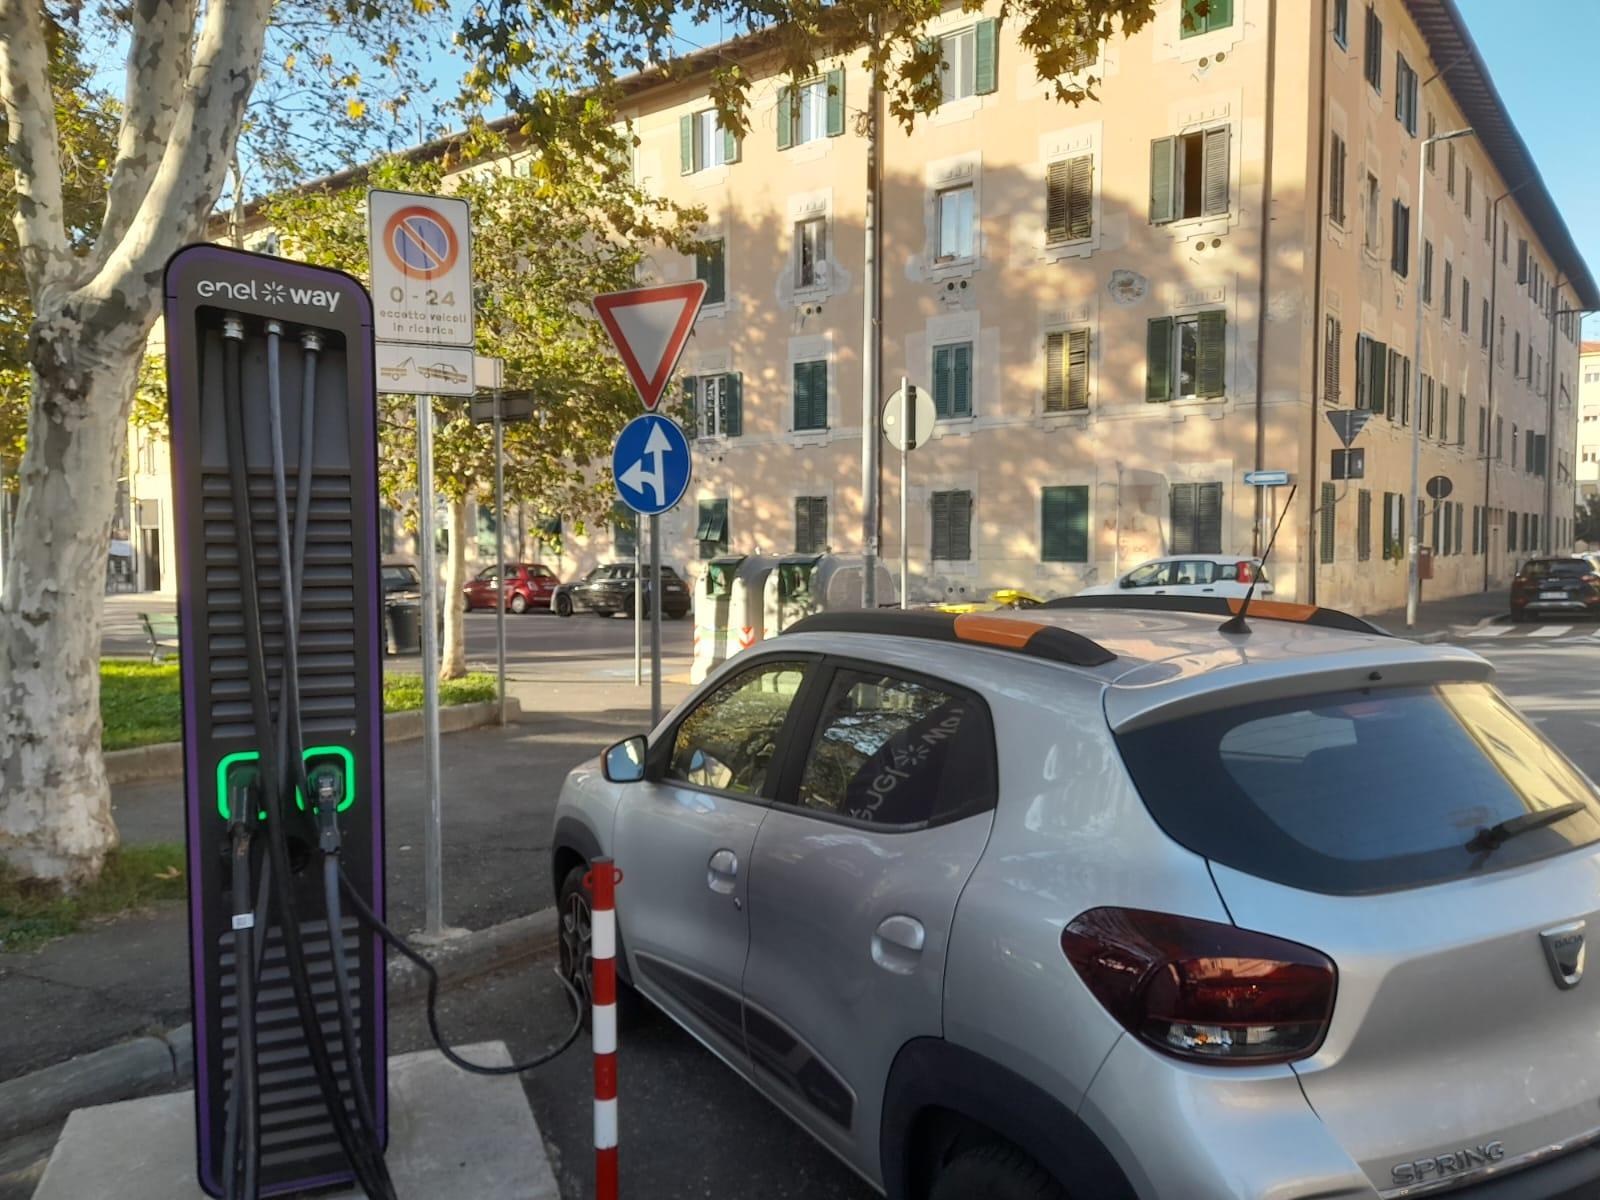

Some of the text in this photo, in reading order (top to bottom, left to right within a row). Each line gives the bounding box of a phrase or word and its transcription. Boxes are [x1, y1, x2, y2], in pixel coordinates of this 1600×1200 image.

[197, 280, 340, 313] enel way
[390, 286, 404, 303] 0
[425, 289, 456, 306] 24
[380, 309, 467, 323] eccetto veicoli
[393, 321, 454, 335] in ricarica
[1391, 1140, 1505, 1185] SPRING
